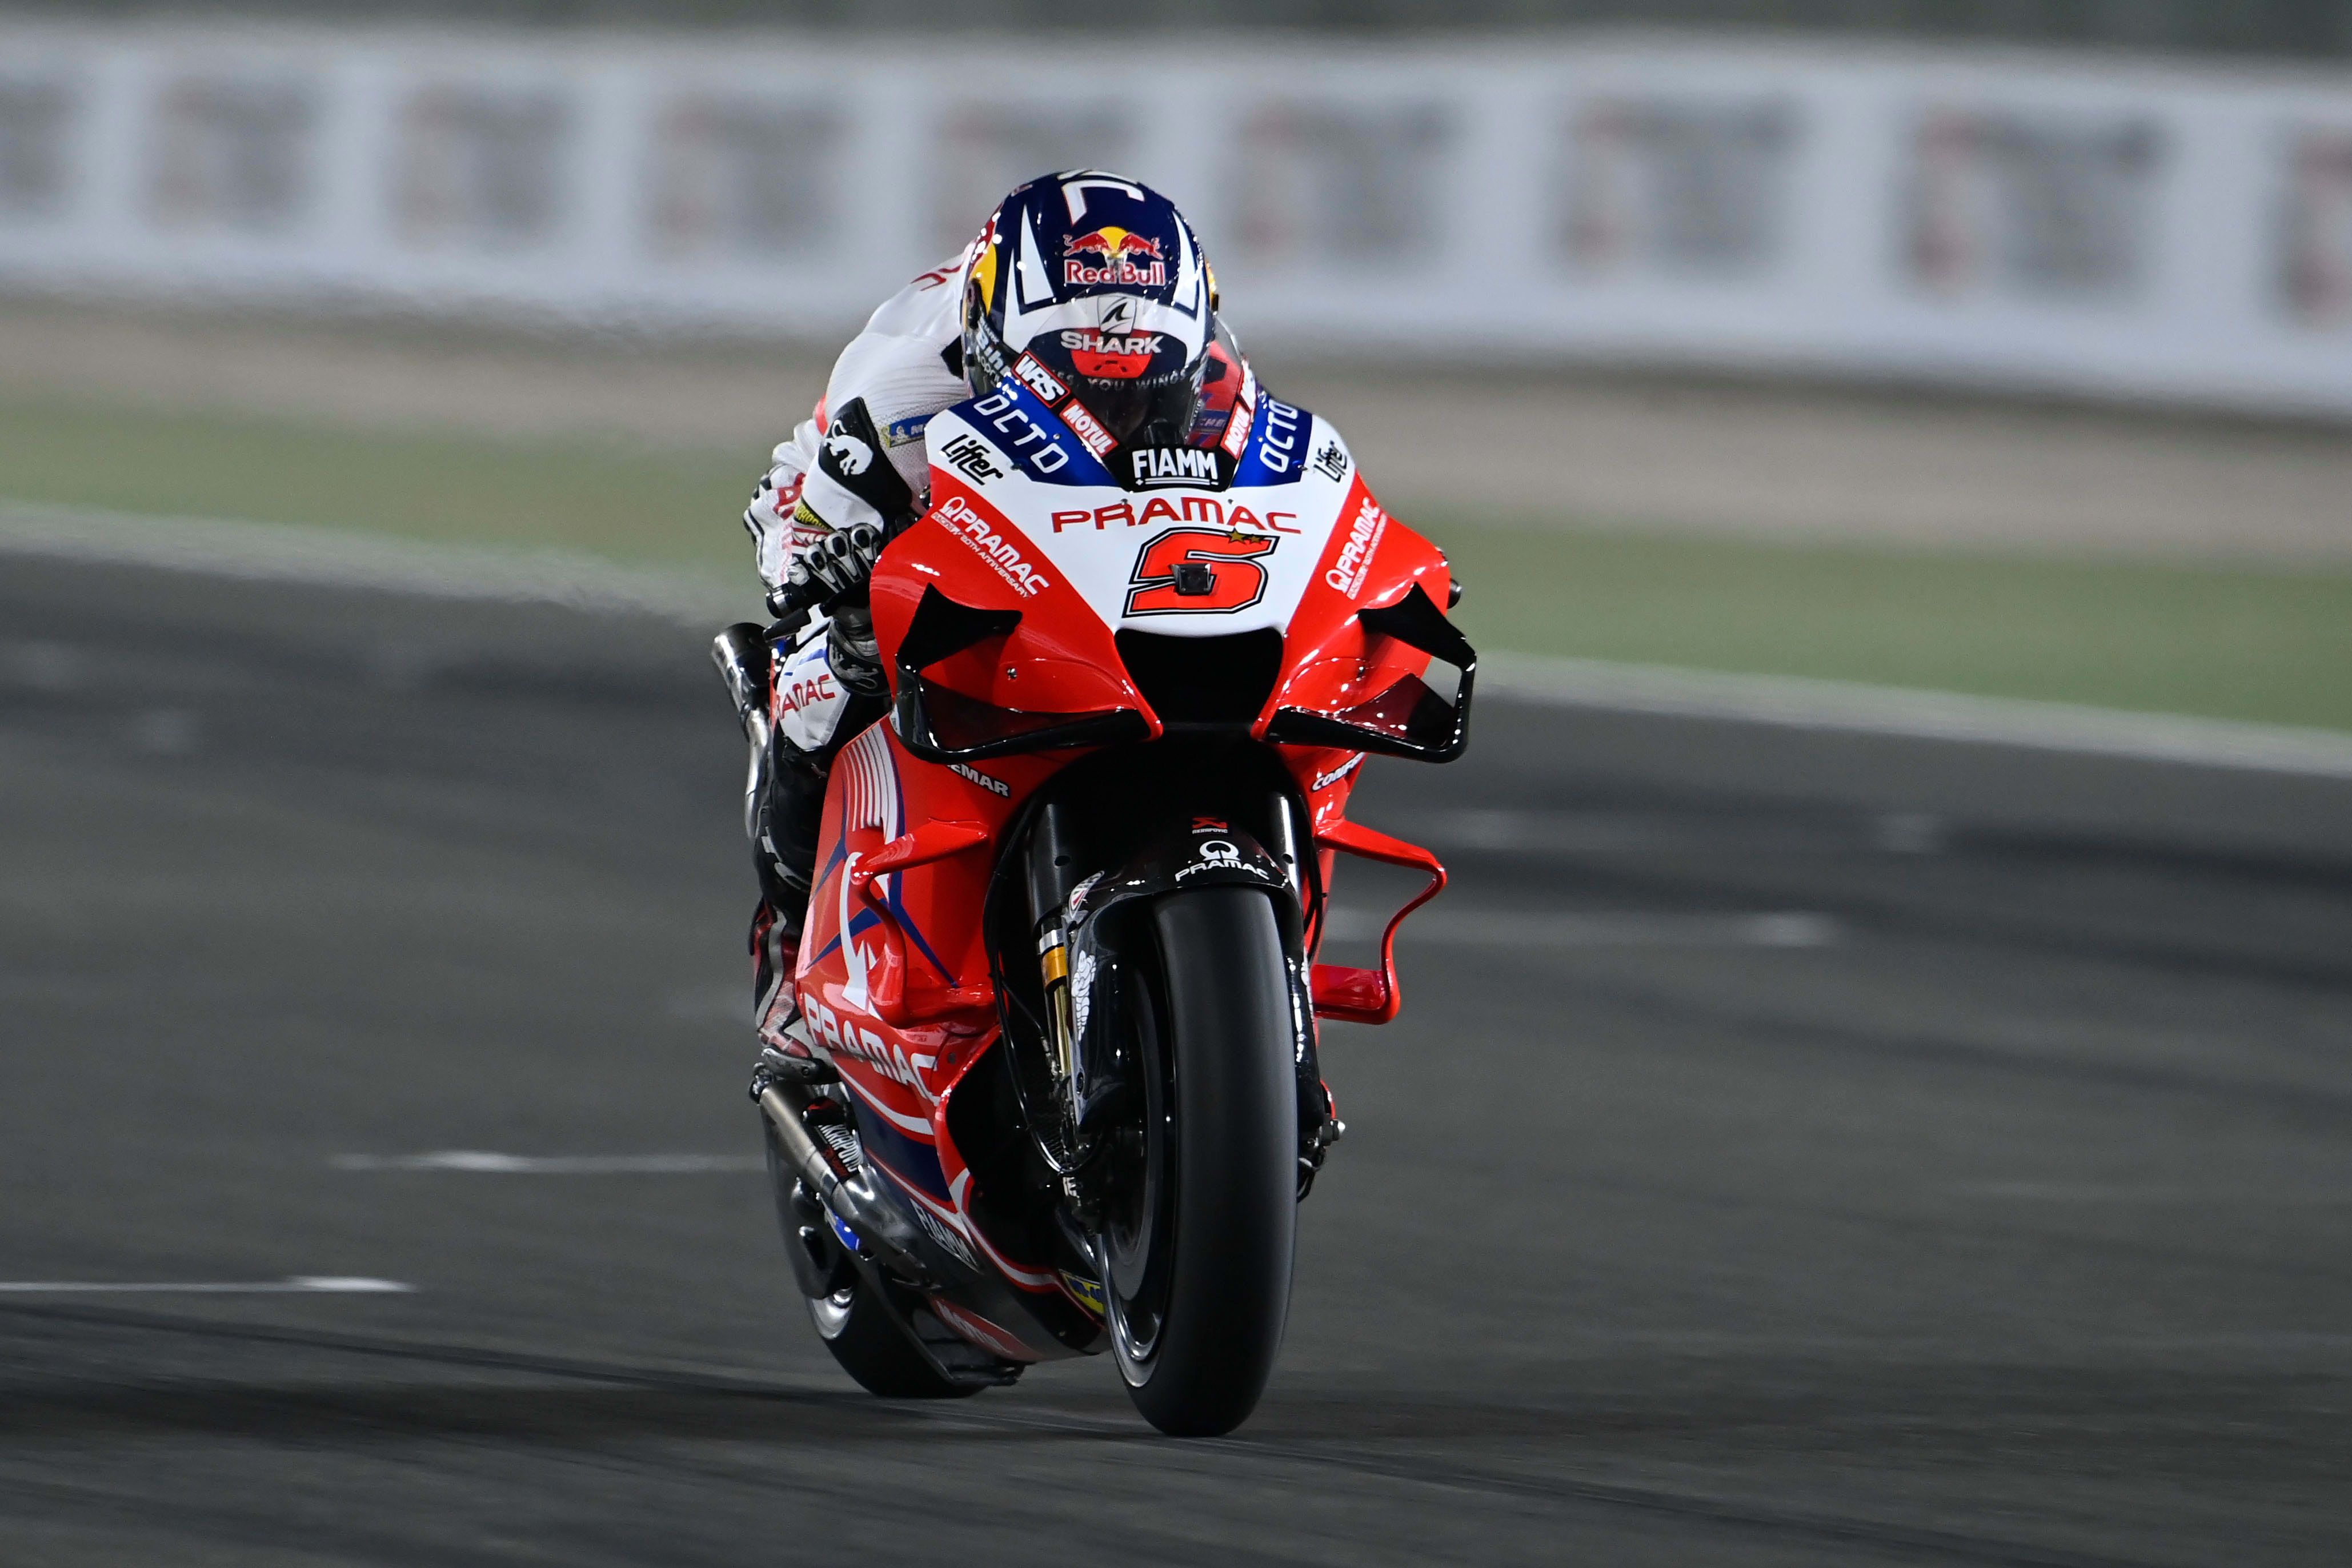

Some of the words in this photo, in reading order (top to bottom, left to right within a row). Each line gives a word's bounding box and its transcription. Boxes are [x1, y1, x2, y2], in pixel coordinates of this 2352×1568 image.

[1064, 259, 1117, 284] Red
[1119, 260, 1165, 286] Bull
[1060, 331, 1164, 355] SHARK
[1015, 355, 1065, 400] WRS
[1087, 377, 1124, 391] YOU
[973, 394, 1069, 474] OCTO
[1063, 404, 1112, 453] MOTUL
[1260, 398, 1298, 472] OCTO
[1132, 448, 1219, 480] FIAMM
[1051, 496, 1301, 535] PRAMAC
[1336, 496, 1380, 577] PRAMAC
[952, 507, 1050, 596] PRAMAC
[1121, 526, 1281, 619] 5
[947, 763, 1008, 796] EMAR
[1175, 860, 1270, 882] PRAMAC
[804, 992, 940, 1107] PRAMAC
